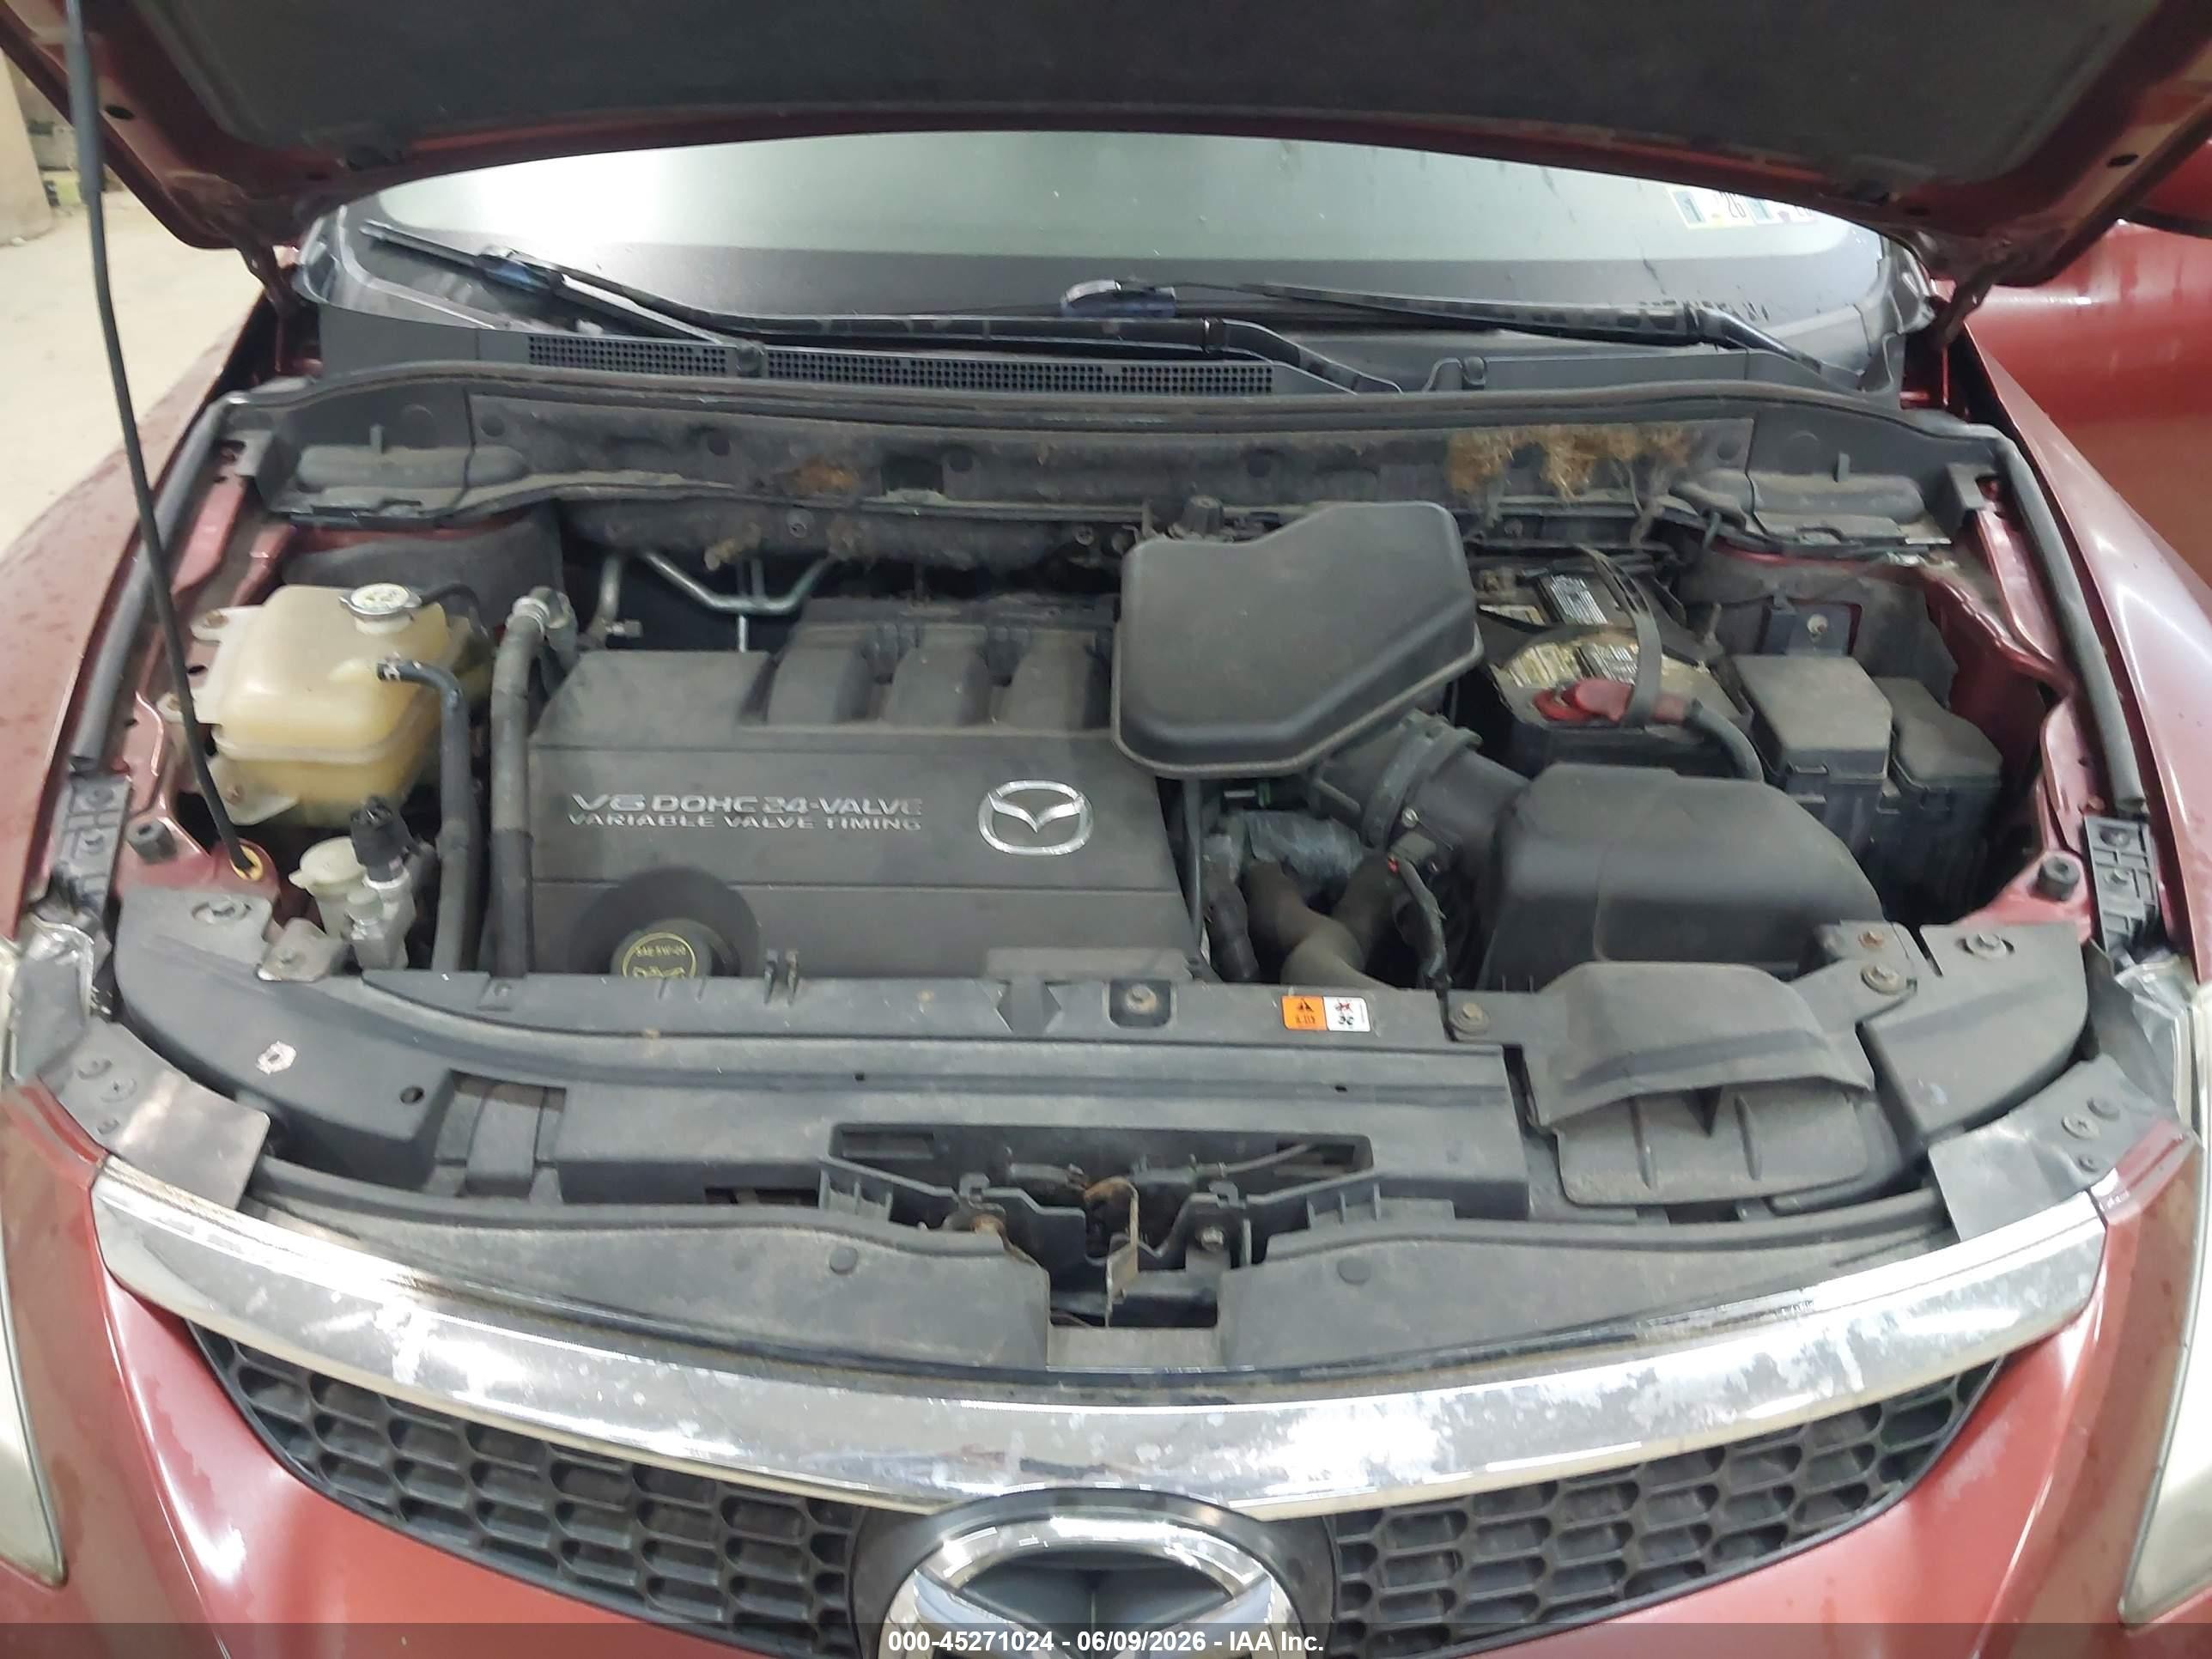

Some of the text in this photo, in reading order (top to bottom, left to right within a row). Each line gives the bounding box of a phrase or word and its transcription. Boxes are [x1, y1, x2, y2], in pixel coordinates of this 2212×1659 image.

[572, 793, 645, 811] V6
[652, 794, 758, 813] DOHC
[568, 814, 921, 830] VARIABLE VALVE TIMING
